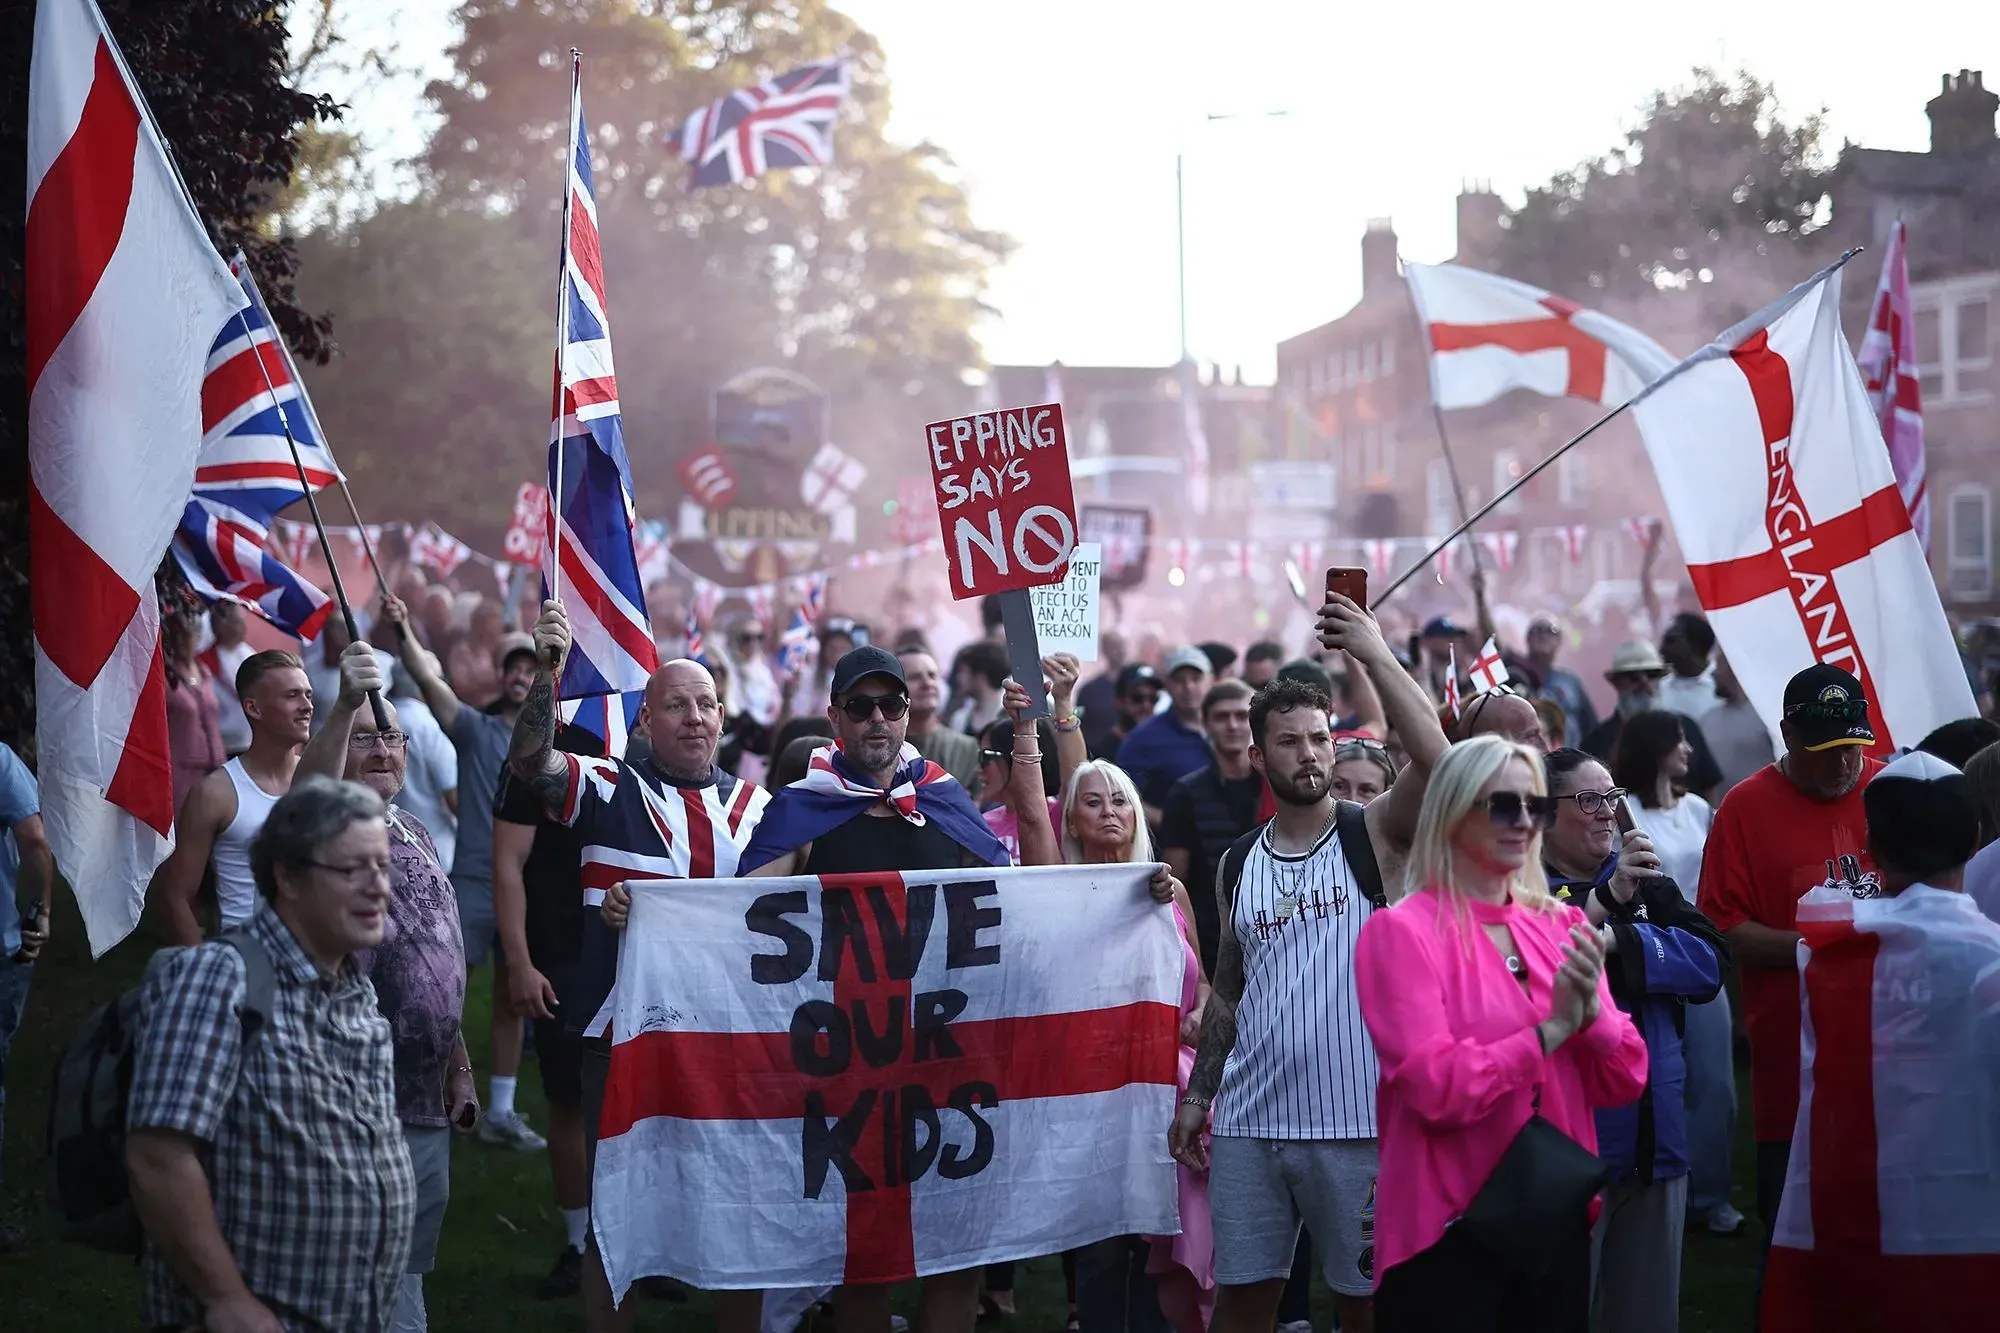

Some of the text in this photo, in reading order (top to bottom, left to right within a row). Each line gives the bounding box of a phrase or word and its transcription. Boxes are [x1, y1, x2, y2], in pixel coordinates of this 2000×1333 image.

[930, 407, 1057, 472] EPPING
[939, 457, 1031, 510] SAYS
[954, 504, 1076, 589] NO
[1769, 435, 1863, 685] ENGLAND
[1037, 607, 1086, 623] AN ACT
[1071, 577, 1087, 591] TO
[1072, 593, 1088, 607] US
[1038, 623, 1092, 638] TREASON
[744, 880, 1003, 985] SAVE
[789, 988, 969, 1078] OUR
[802, 1080, 999, 1200] KIDS
